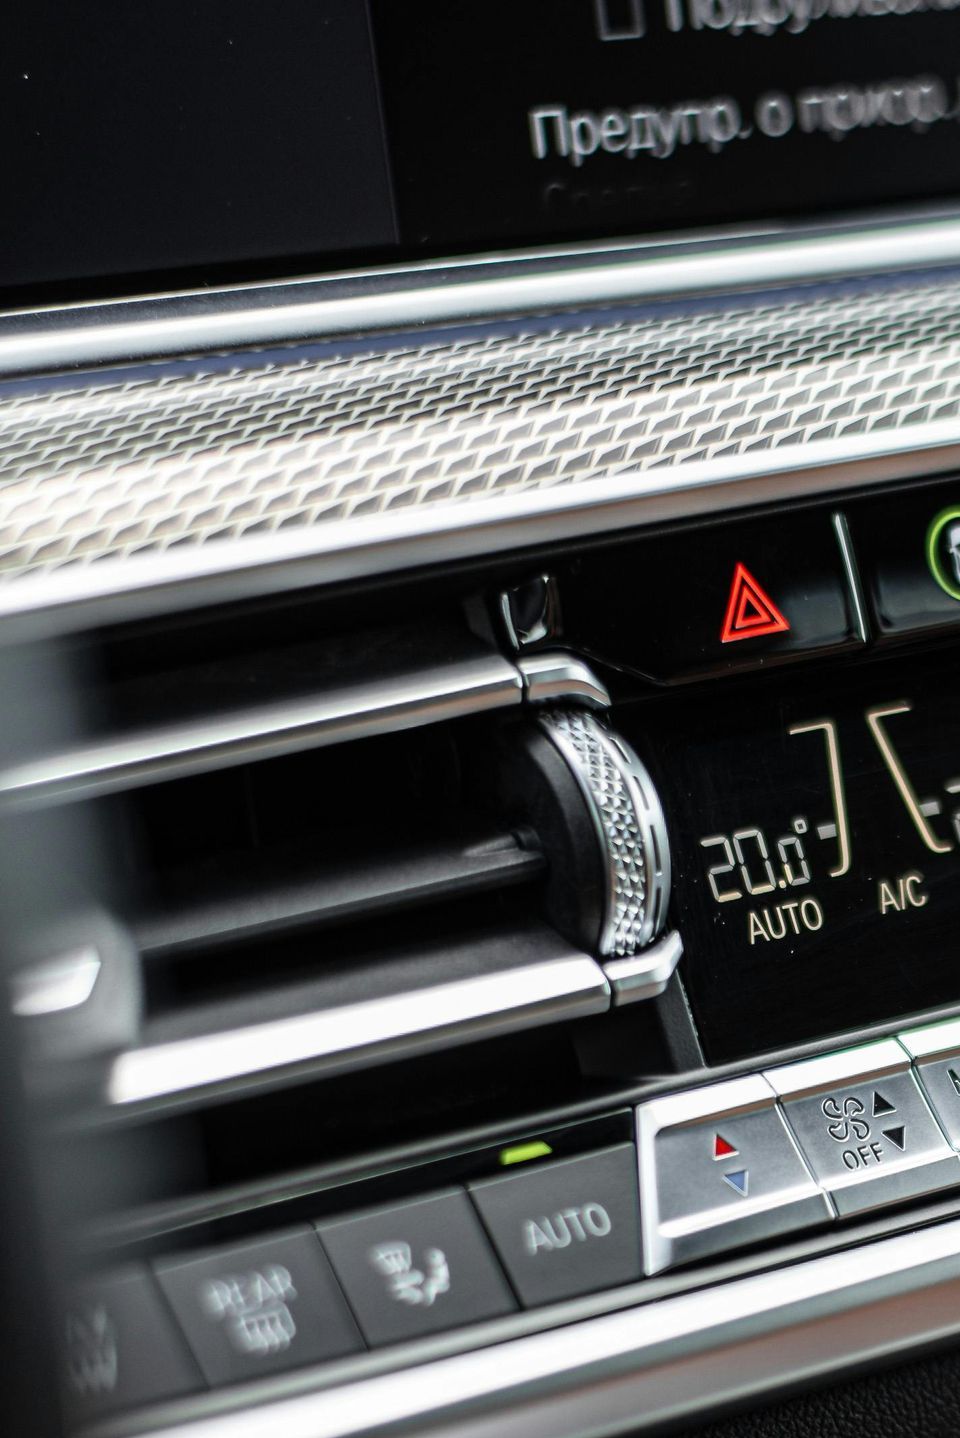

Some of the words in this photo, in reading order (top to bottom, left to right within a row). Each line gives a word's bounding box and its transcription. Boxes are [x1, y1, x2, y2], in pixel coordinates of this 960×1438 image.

[747, 899, 825, 945] AUTO
[878, 874, 929, 915] A/C
[842, 1142, 886, 1172] OFF
[523, 1201, 611, 1255] AUTO
